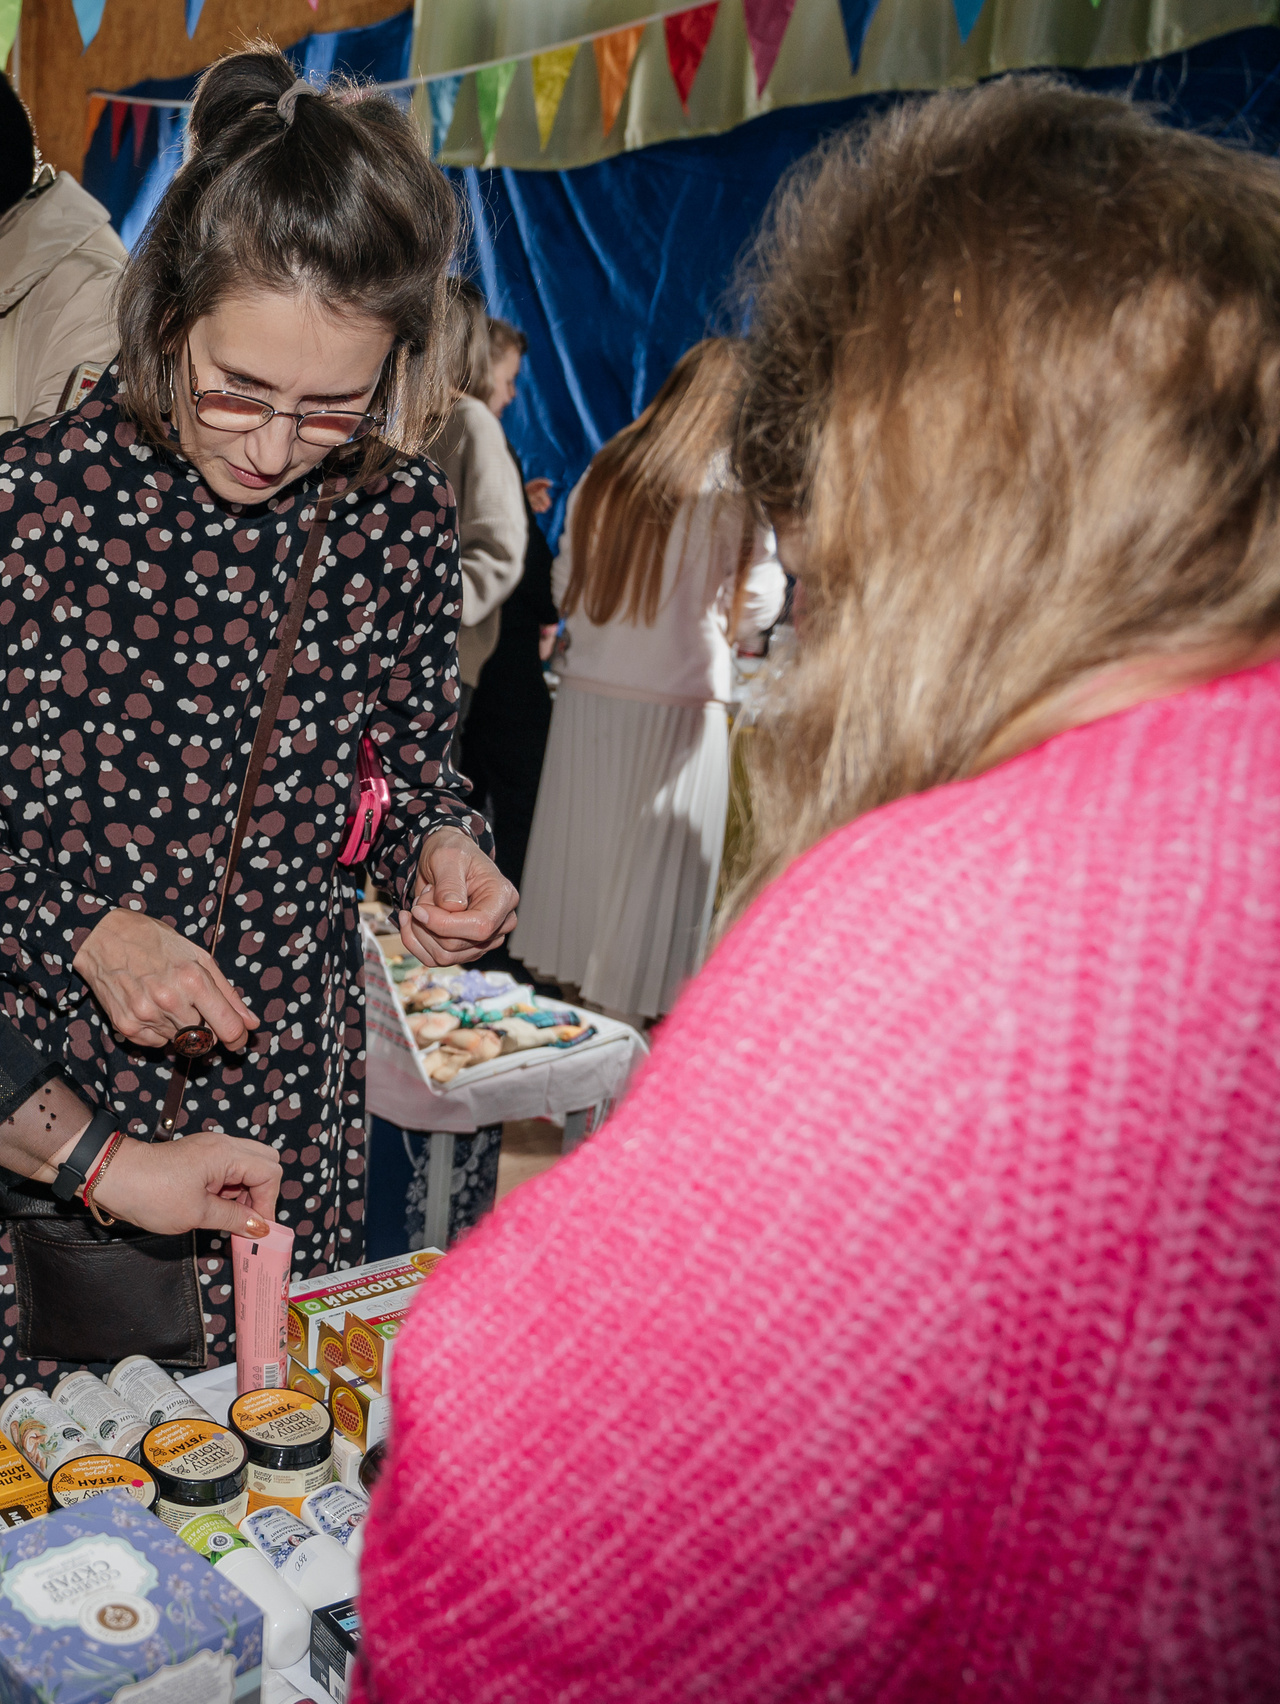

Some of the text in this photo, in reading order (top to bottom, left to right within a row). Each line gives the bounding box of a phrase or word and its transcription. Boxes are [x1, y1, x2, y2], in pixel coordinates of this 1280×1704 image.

[376, 1270, 396, 1279] БОЛИ
[398, 1265, 414, 1273] ПРИ
[321, 1271, 426, 1307] МЕДОВЫЙ
[326, 1278, 366, 1293] СУСТАВАХ
[255, 1403, 295, 1421] УБТАН
[269, 1411, 306, 1431] honey
[278, 1417, 315, 1438] sunny
[169, 1433, 207, 1454] УБТАН
[183, 1442, 222, 1465] honey
[193, 1447, 229, 1471] sunny
[78, 1476, 126, 1486] УБТАН
[253, 1474, 272, 1483] honey
[42, 1562, 109, 1591] СКРАБ
